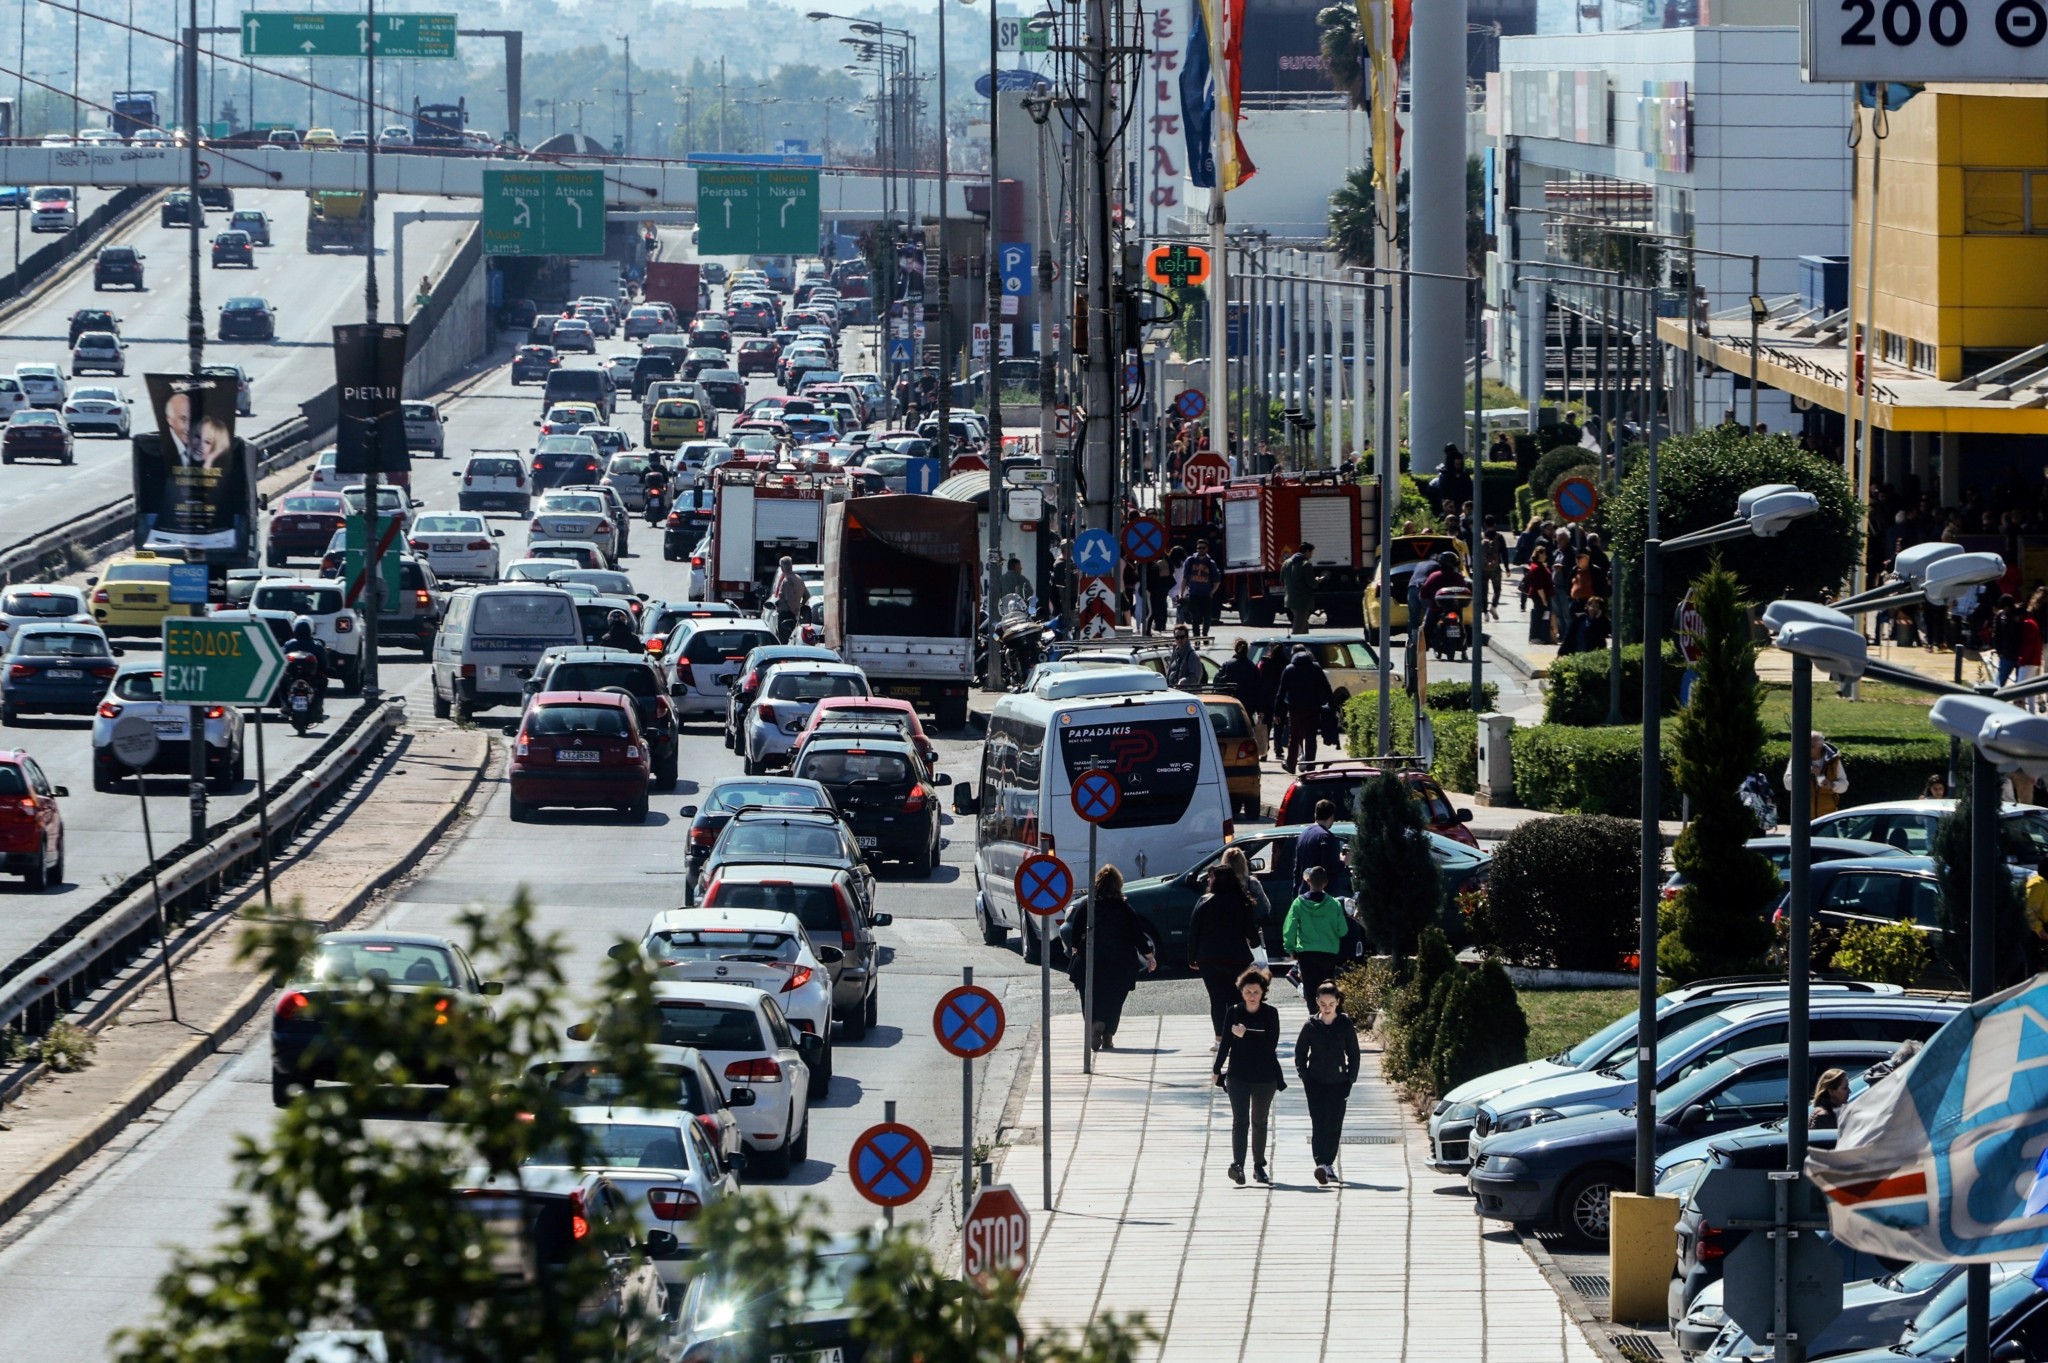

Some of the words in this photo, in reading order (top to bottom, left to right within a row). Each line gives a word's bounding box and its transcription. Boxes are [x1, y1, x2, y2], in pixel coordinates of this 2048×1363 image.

[1841, 0, 1968, 47] 200
[1001, 22, 1019, 46] SP
[1148, 8, 1180, 207] έπιπλα
[502, 187, 540, 197] Athina
[555, 187, 593, 197] Athina
[701, 187, 748, 197] Peiraias
[769, 187, 807, 197] Nikaia
[485, 243, 520, 254] Lamia
[168, 629, 242, 657] ΕΞΟΔΟΣ
[472, 639, 509, 649] ΡΗΓΚΟΣ
[166, 665, 208, 691] EXIT
[1068, 726, 1131, 738] PAPADAKIS
[967, 1214, 1025, 1275] STOP
